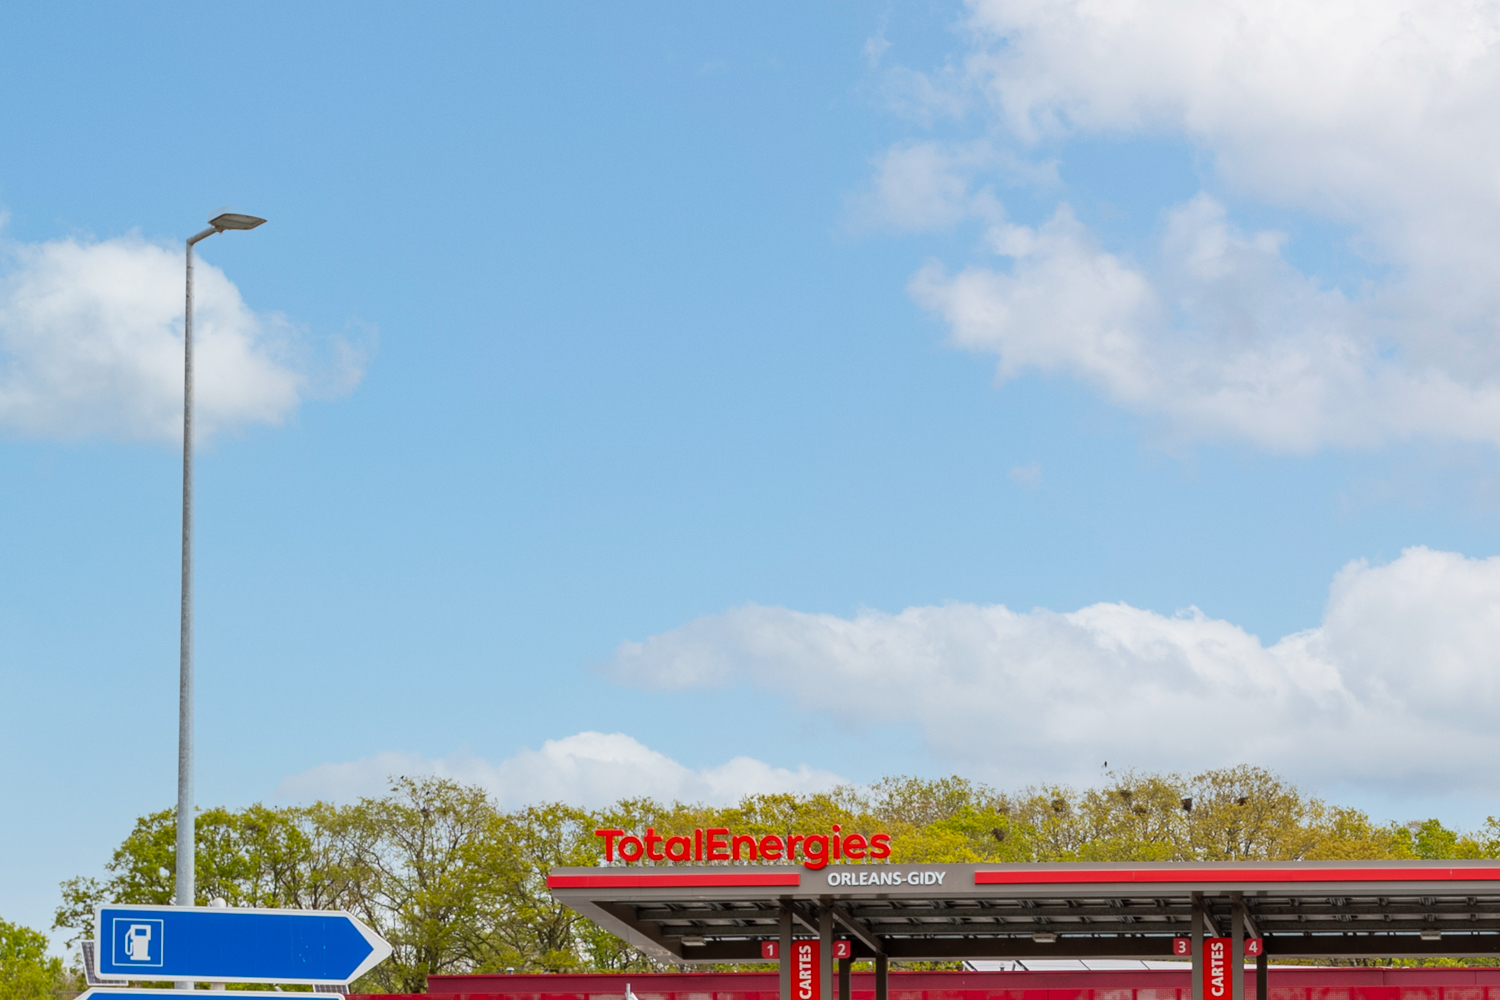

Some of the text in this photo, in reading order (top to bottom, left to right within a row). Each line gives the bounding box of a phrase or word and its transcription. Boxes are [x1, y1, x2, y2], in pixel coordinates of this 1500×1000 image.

[595, 824, 892, 869] TotalEnergies
[827, 871, 946, 886] ORLEANS-GIDY
[766, 944, 774, 956] 1
[838, 944, 846, 956] 2
[1178, 941, 1186, 954] 3
[1248, 941, 1258, 953] 4
[798, 945, 812, 1000] CARTES
[1210, 942, 1224, 997] CARTES
